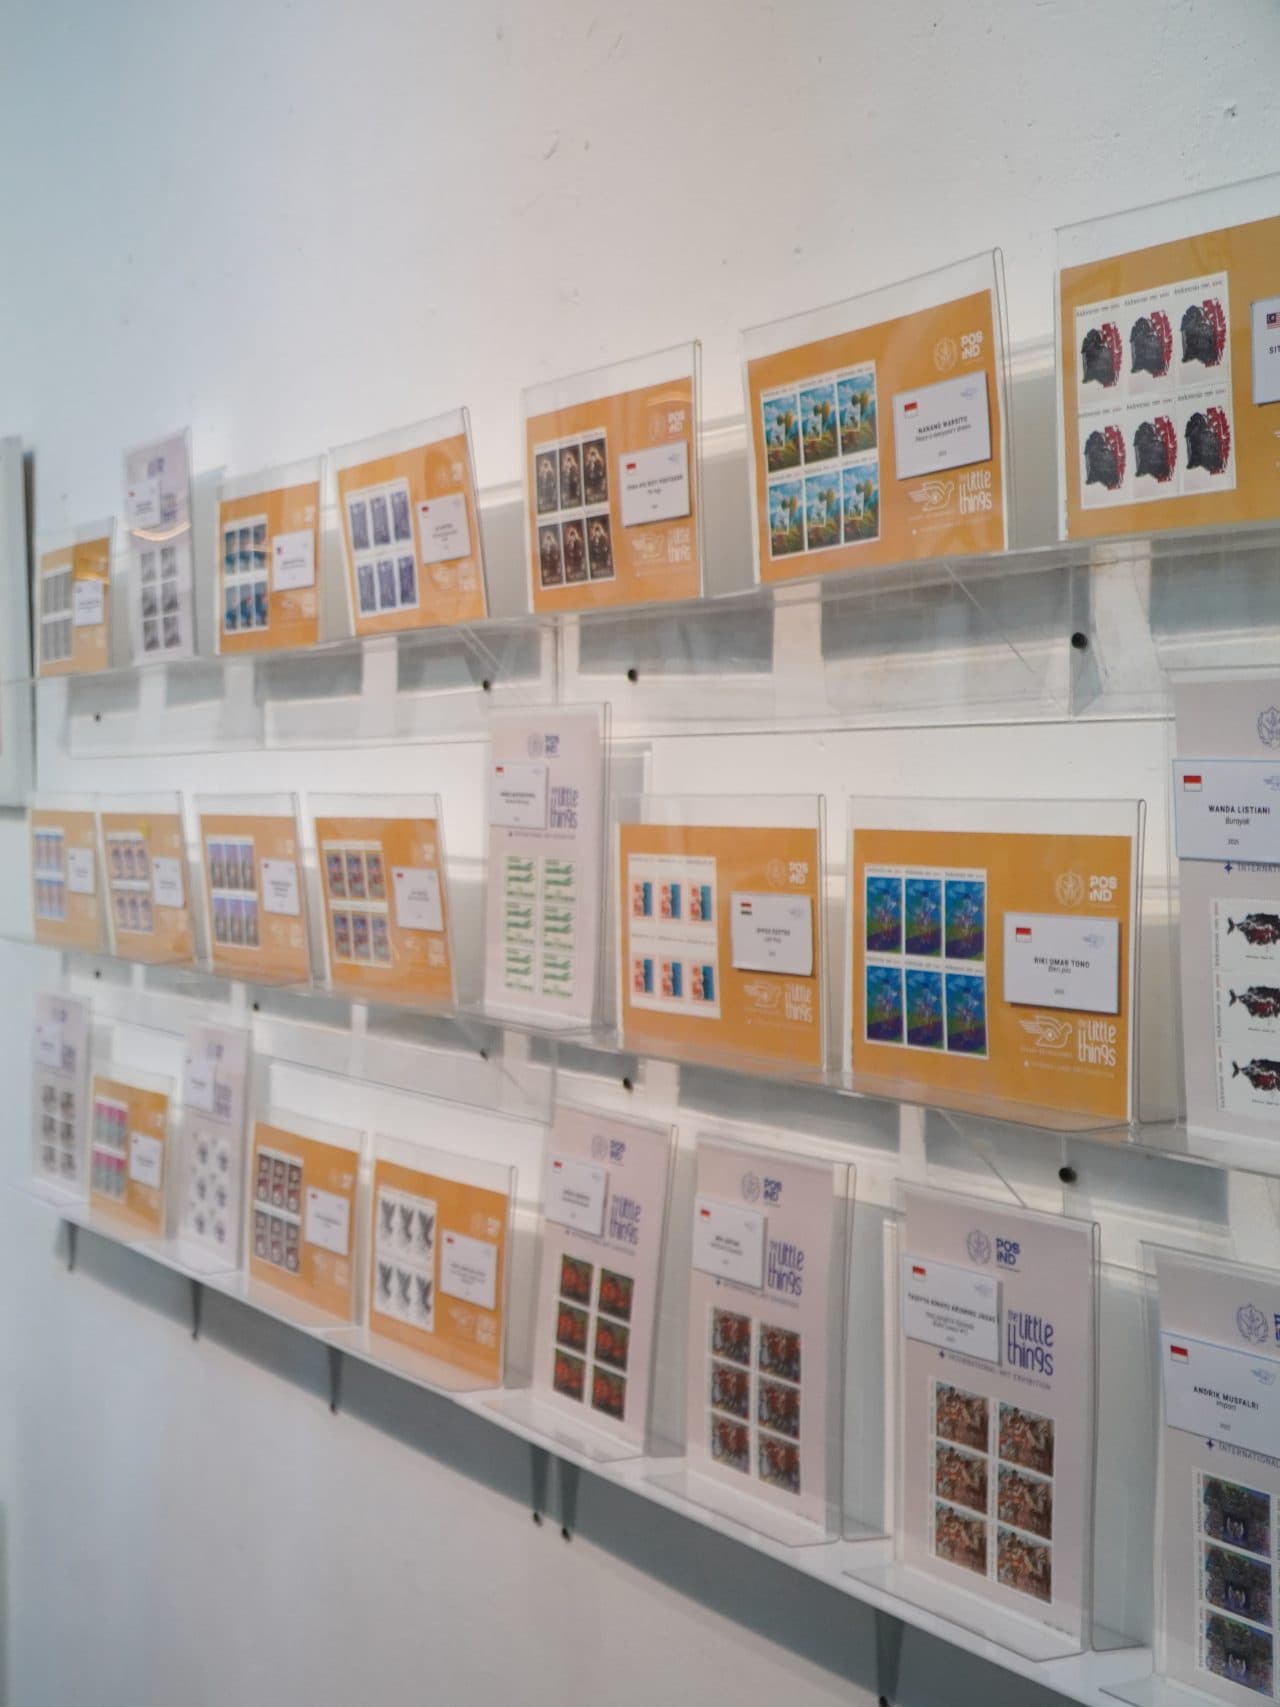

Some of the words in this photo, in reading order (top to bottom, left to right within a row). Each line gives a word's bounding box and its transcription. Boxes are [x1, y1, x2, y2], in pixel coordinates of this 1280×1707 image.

[1208, 804, 1235, 814] WANDA
[1237, 805, 1271, 815] LISTIANI
[1089, 875, 1118, 889] POS
[995, 1237, 1021, 1255] POS
[1007, 1322, 1054, 1377] things
[1193, 1385, 1220, 1399] ANDRIK
